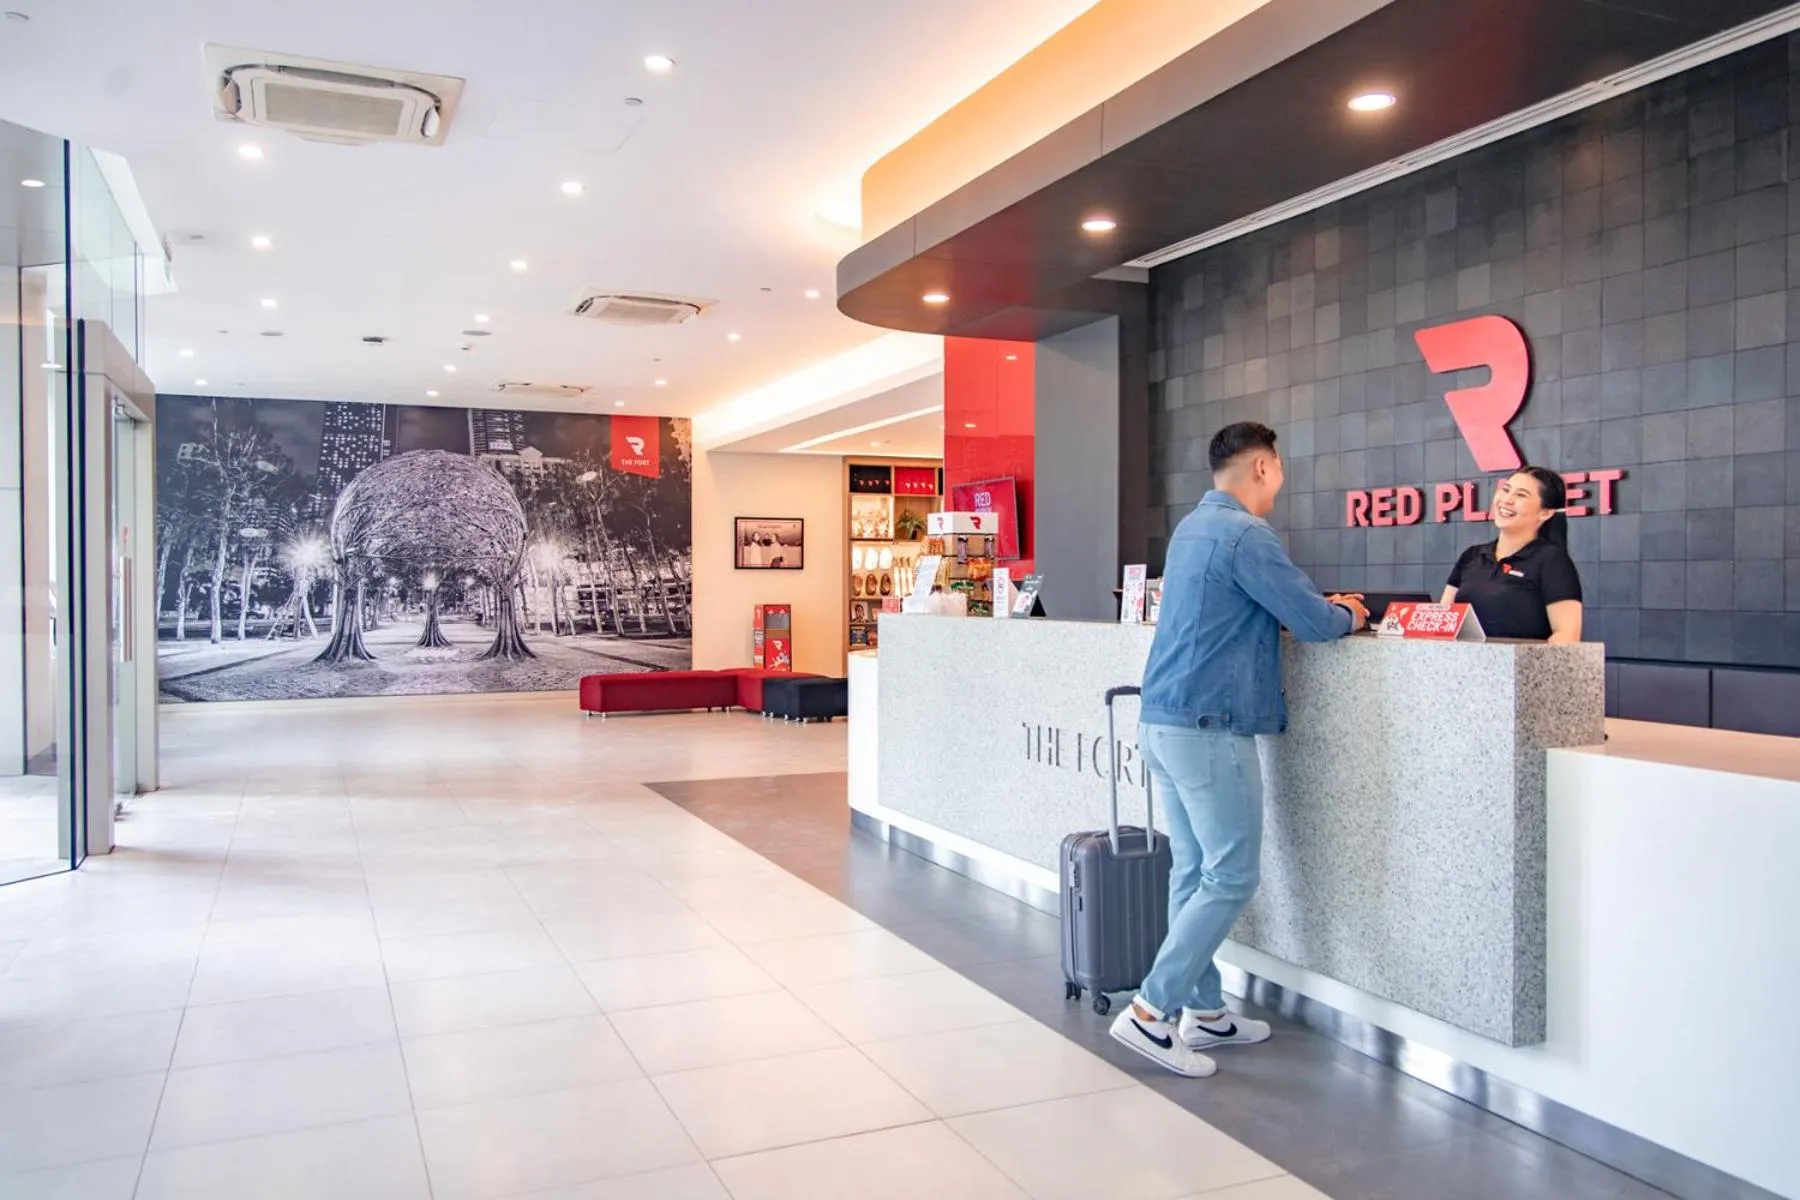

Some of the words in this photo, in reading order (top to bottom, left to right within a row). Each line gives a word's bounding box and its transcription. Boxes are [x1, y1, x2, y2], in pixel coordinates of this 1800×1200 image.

[974, 492, 991, 507] RED
[1346, 487, 1422, 528] RED
[1435, 469, 1623, 523] PLET
[1411, 611, 1459, 622] EXPRESS
[1407, 621, 1457, 632] CHECK-IN
[1022, 722, 1064, 767] THE
